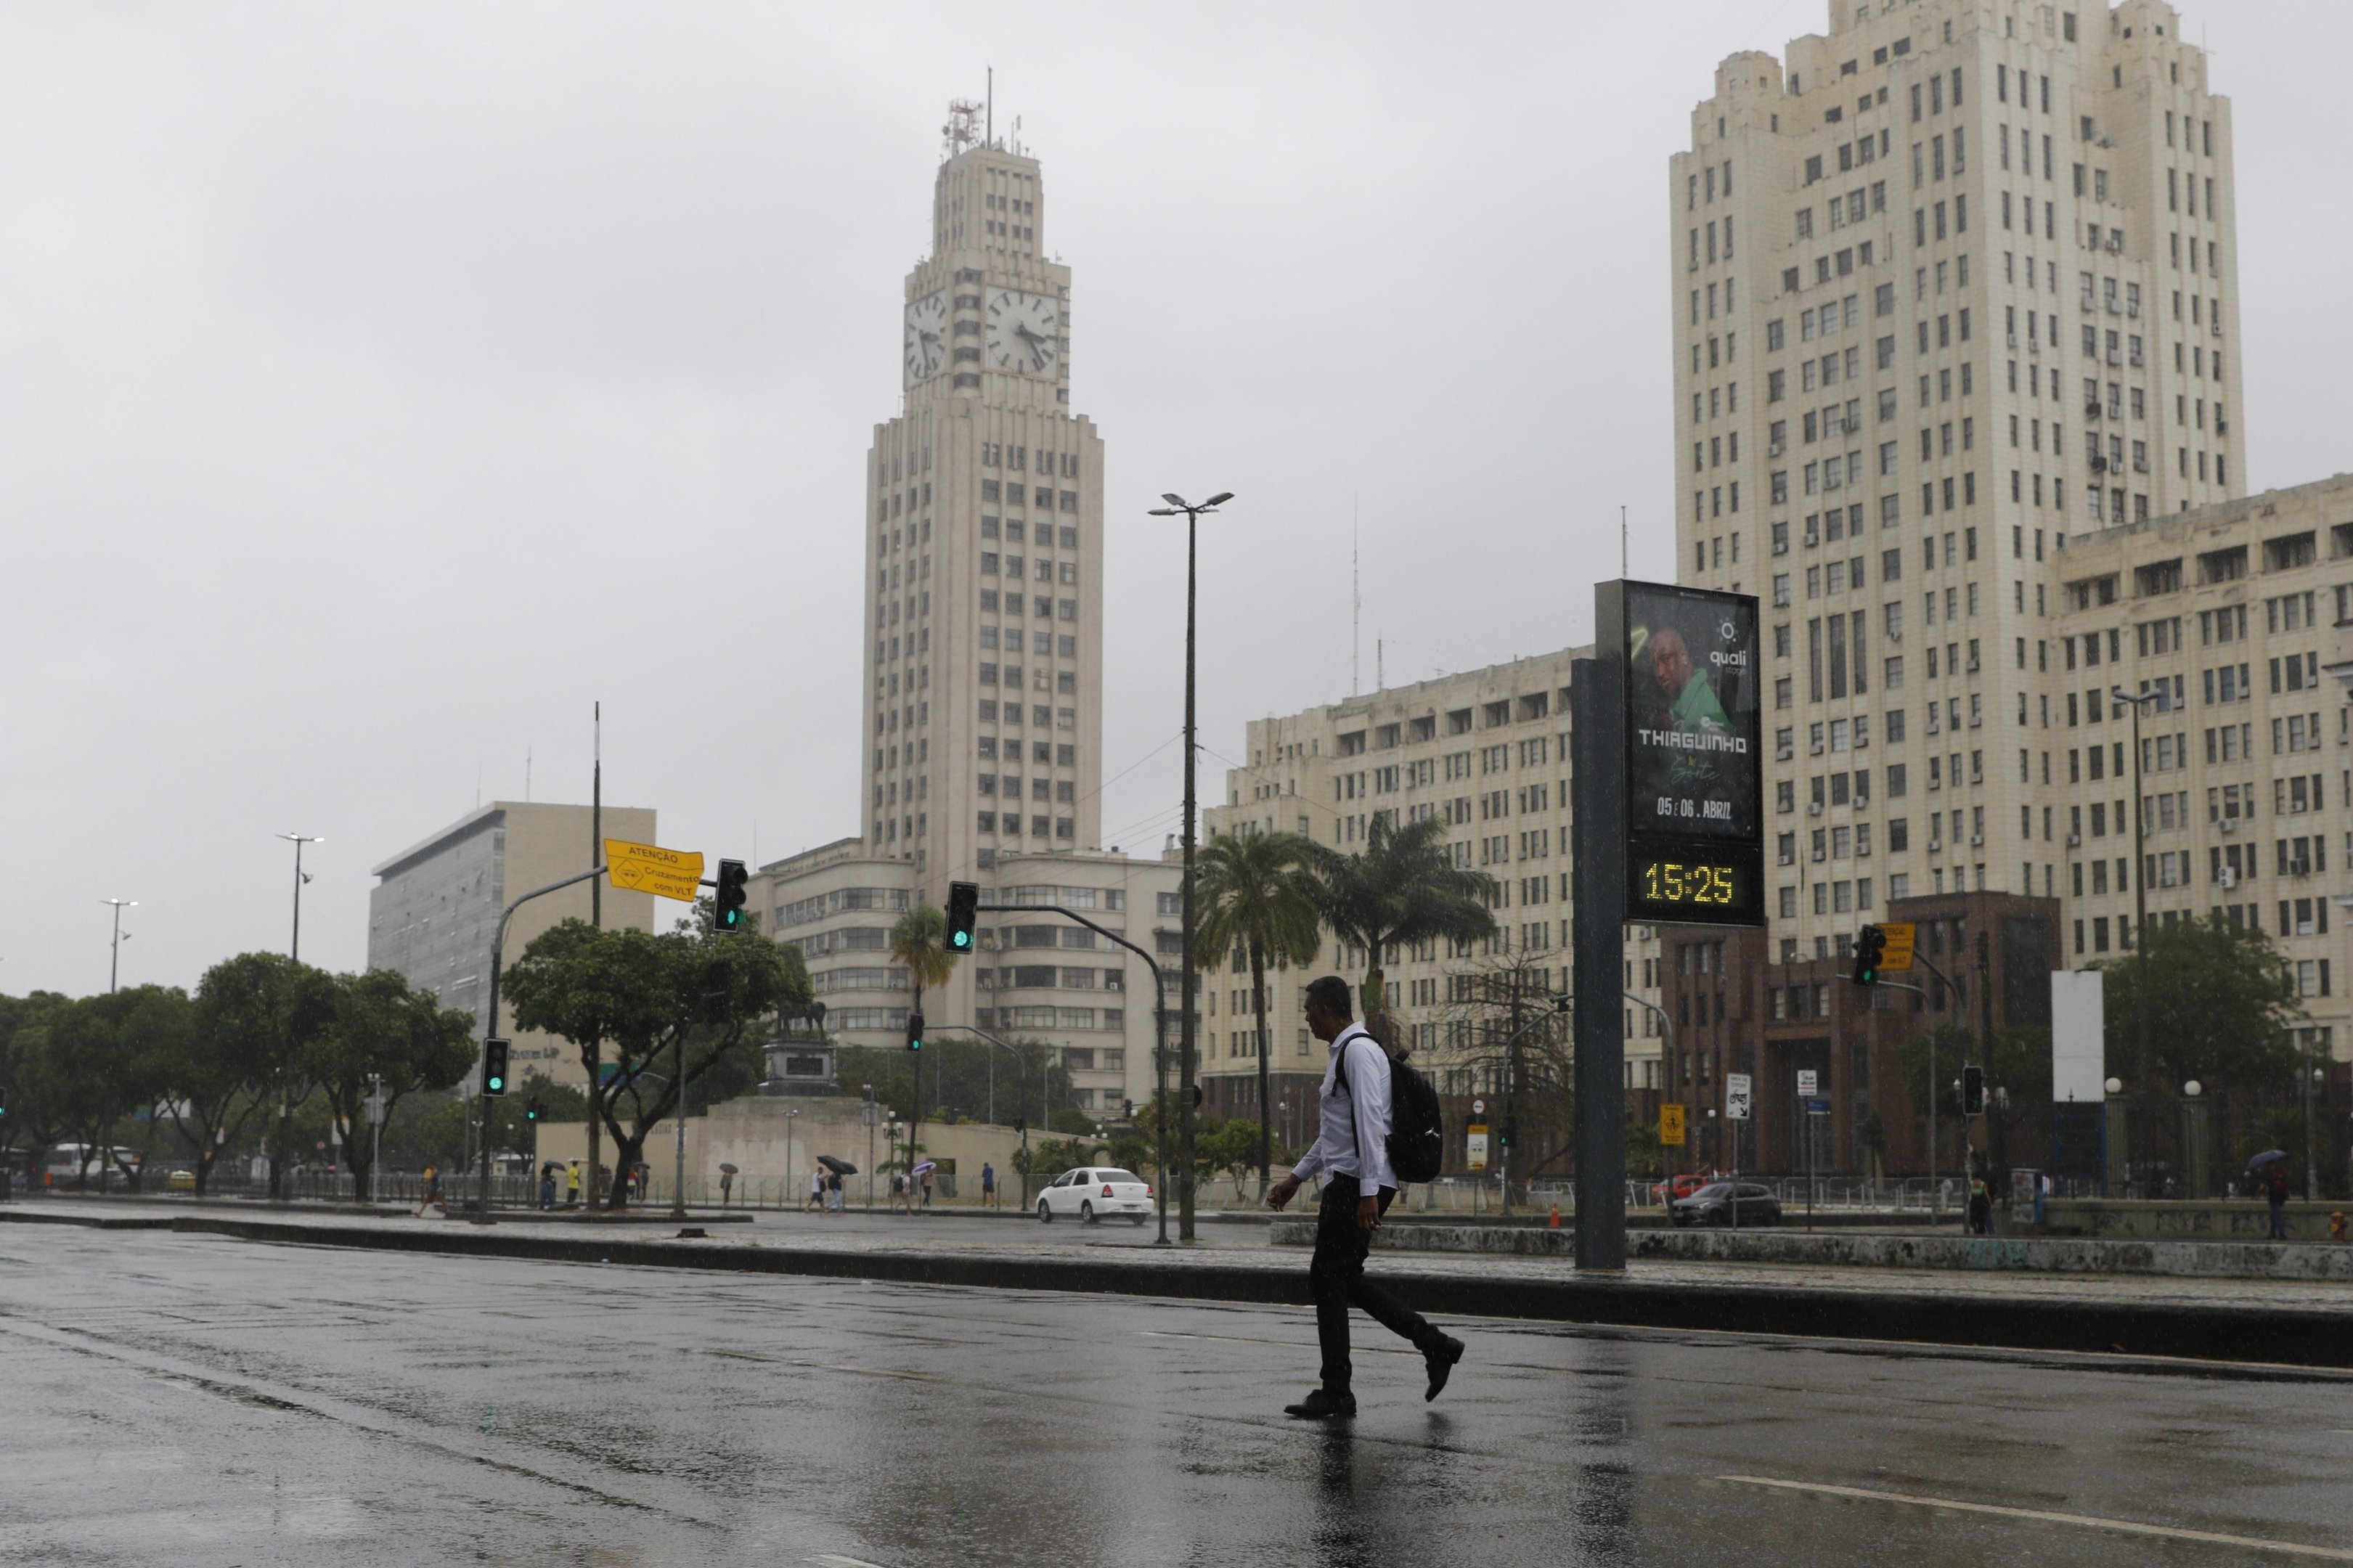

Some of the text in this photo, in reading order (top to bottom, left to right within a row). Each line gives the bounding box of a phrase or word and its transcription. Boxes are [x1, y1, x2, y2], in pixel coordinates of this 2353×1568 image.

[1710, 650, 1746, 666] quali
[1639, 728, 1747, 754] THIAGUINHO
[1657, 796, 1672, 816] 05
[1680, 799, 1695, 817] 06
[1702, 800, 1732, 820] ABRIL
[629, 846, 678, 864] ATENÇÃO
[644, 866, 700, 883] Cruzamento
[1646, 862, 1732, 903] 15:25
[654, 882, 692, 897] com VLT
